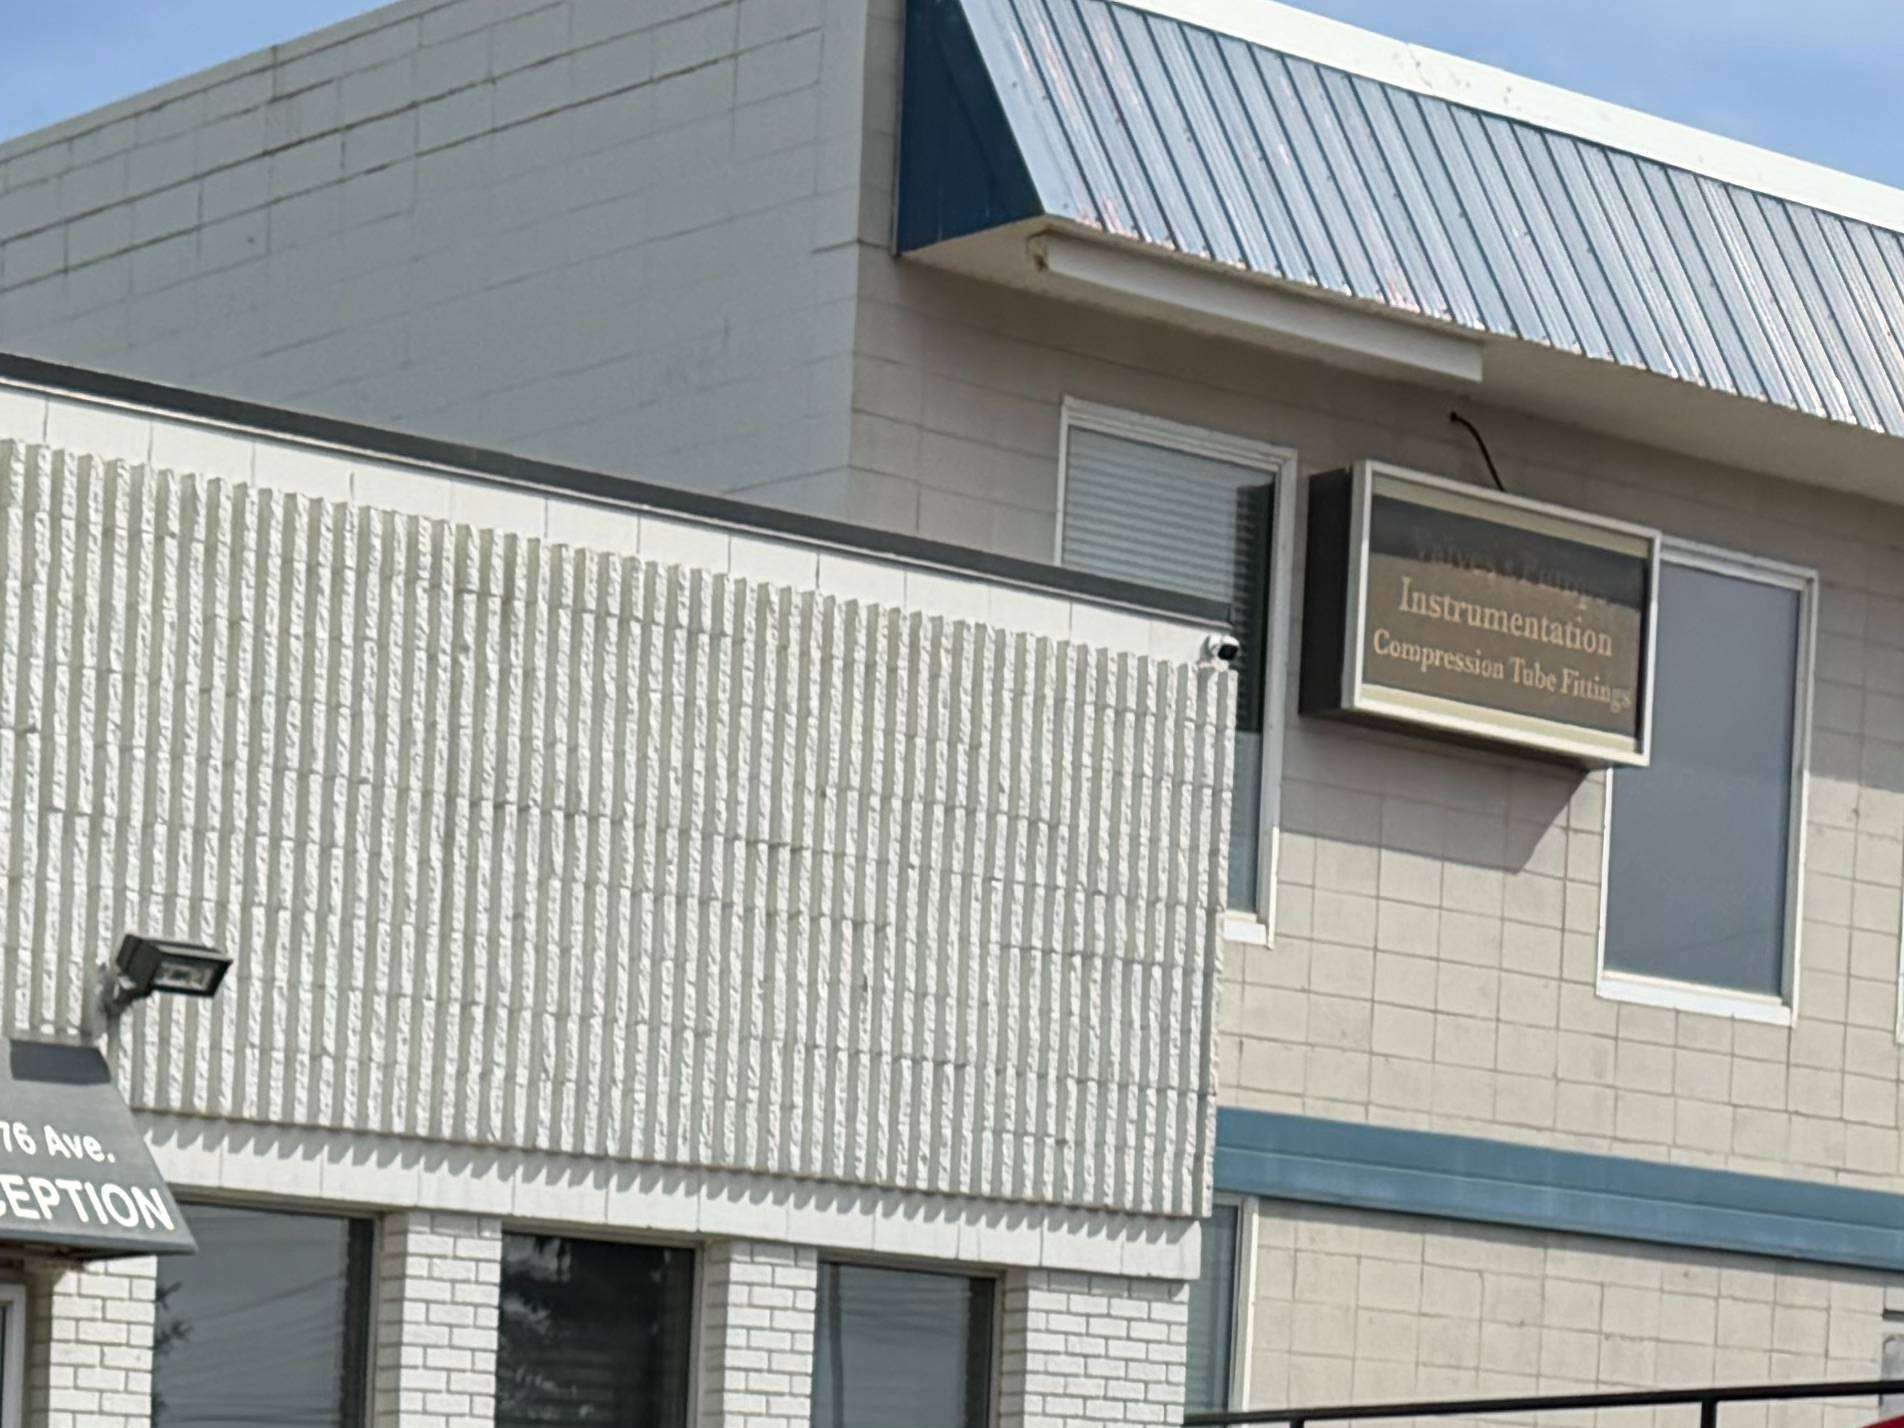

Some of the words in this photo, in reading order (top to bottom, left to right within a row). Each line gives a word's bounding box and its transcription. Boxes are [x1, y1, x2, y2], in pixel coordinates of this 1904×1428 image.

[1398, 576, 1614, 657] Instrumentation
[1373, 628, 1505, 677] Compression
[1510, 656, 1557, 693] Tube
[1560, 668, 1633, 713] Fittings
[45, 1124, 117, 1164] Ave.
